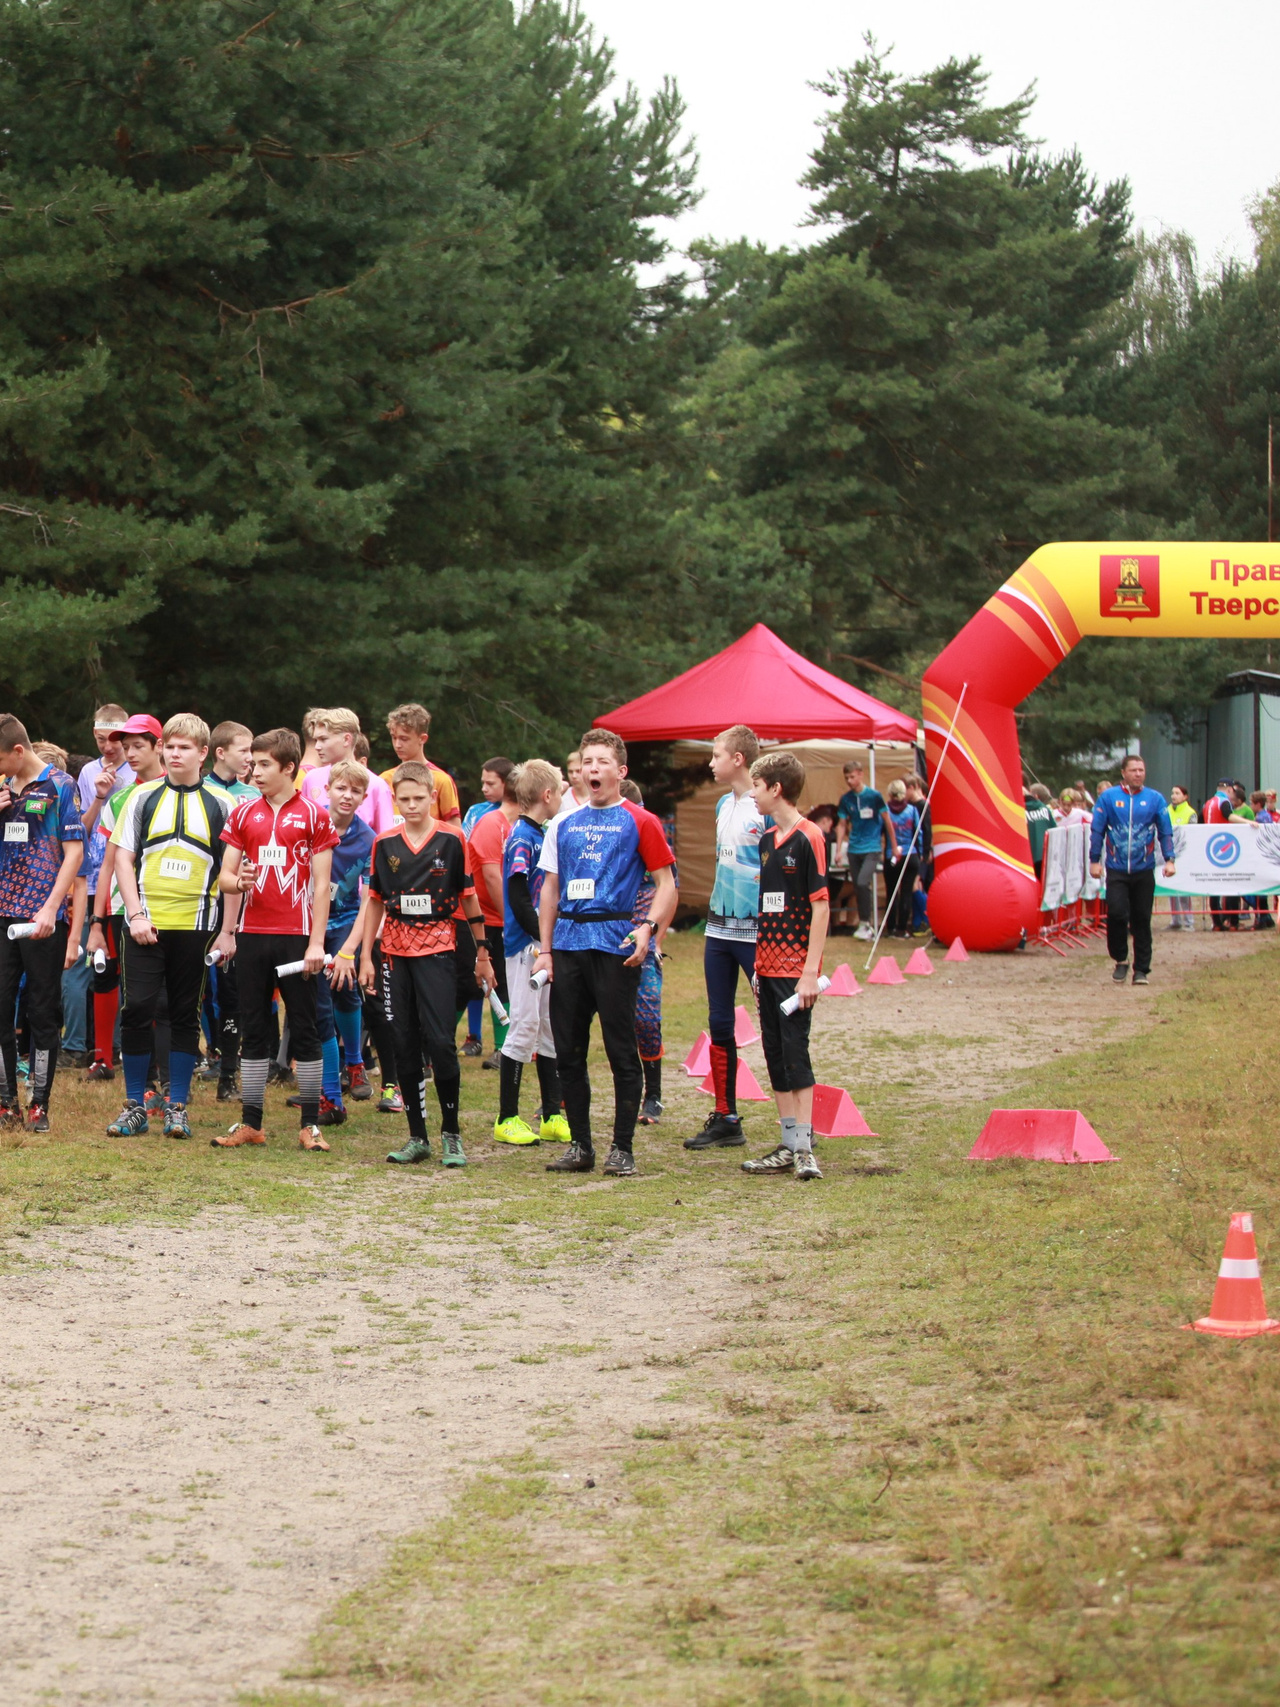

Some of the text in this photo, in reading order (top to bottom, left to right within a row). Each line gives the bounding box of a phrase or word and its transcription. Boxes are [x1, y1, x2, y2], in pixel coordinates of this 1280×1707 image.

[1210, 559, 1280, 587] Прав
[1189, 591, 1280, 620] Тверс
[8, 825, 25, 834] 1009
[263, 850, 281, 858] 1011
[166, 861, 187, 872] 1110
[571, 883, 591, 892] 1014
[405, 898, 427, 907] 1013
[766, 895, 782, 904] 1015
